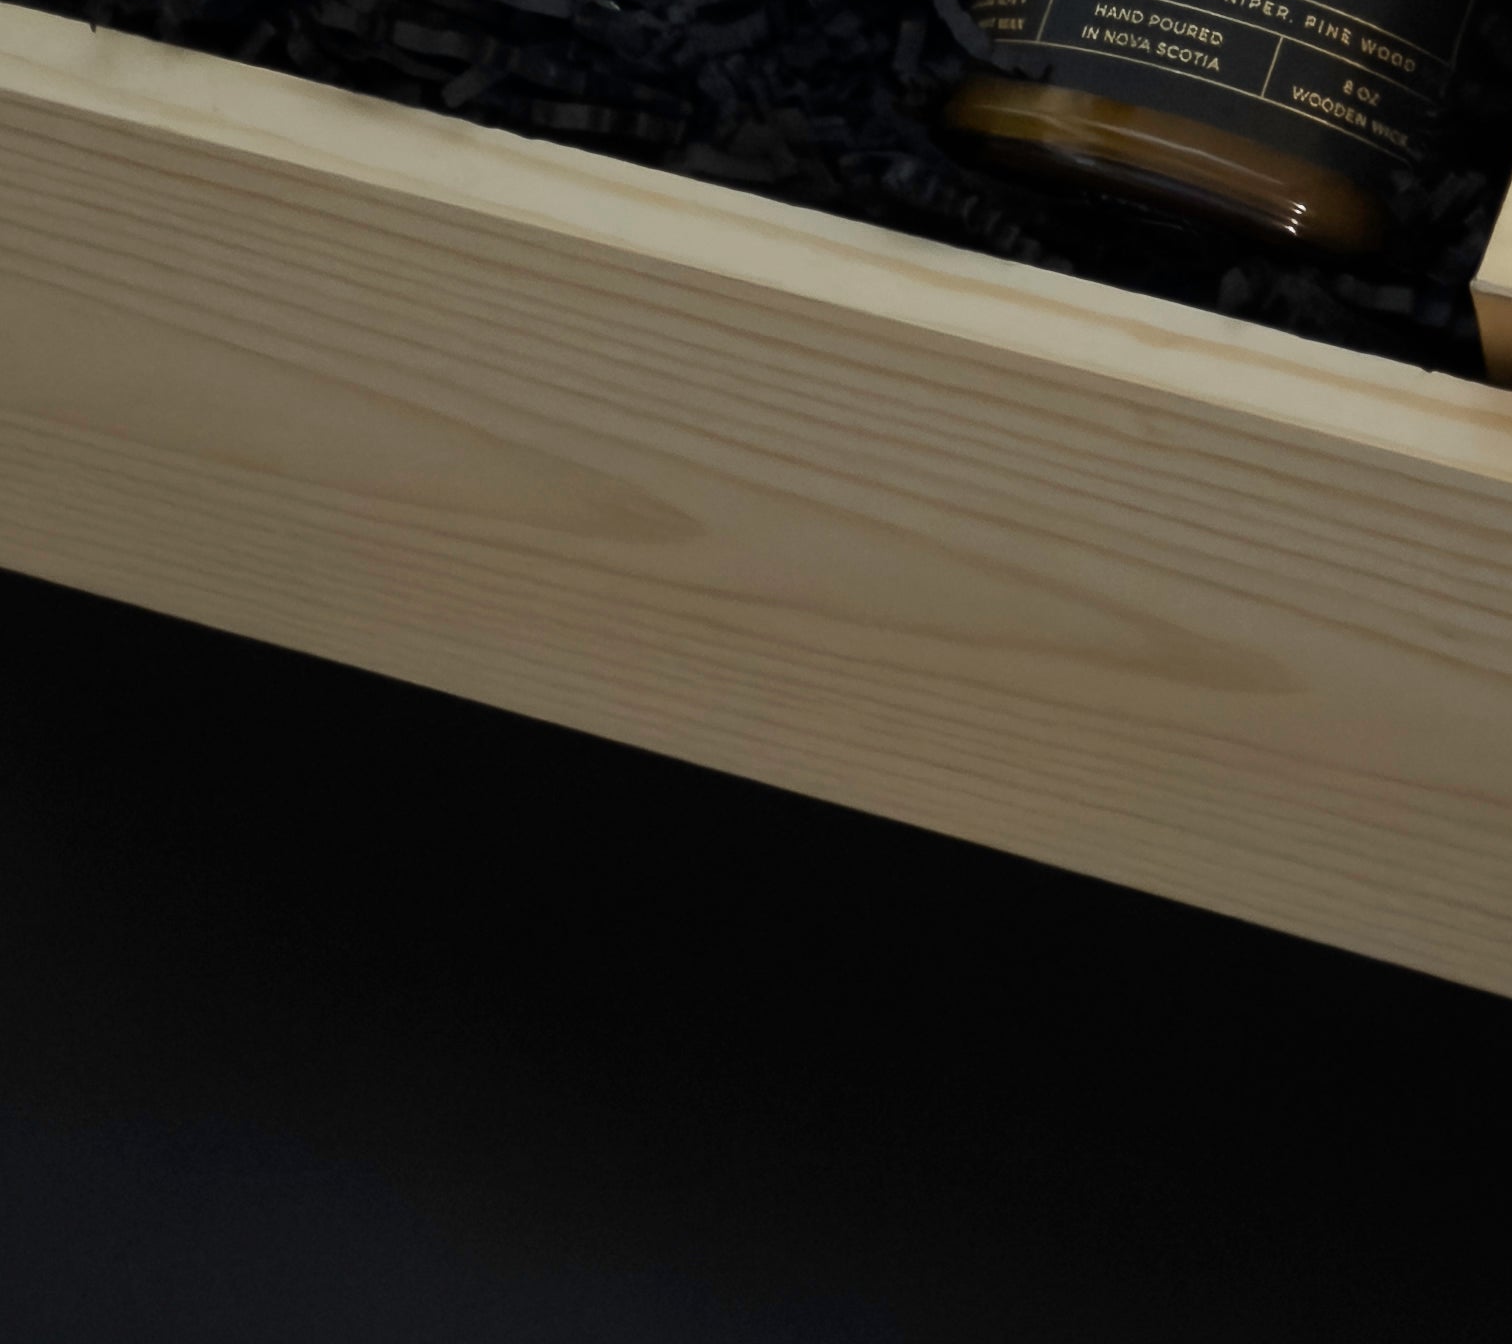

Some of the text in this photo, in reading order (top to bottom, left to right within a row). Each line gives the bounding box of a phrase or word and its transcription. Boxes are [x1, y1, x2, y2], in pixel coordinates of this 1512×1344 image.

[1081, 24, 1221, 72] IN NOVA SCOTIA
[1094, 3, 1225, 48] HAND POURED
[1304, 14, 1353, 46] PINE
[1360, 36, 1417, 74] WOOD
[1292, 85, 1368, 129] WOODEN
[1342, 79, 1382, 108] 8 OZ
